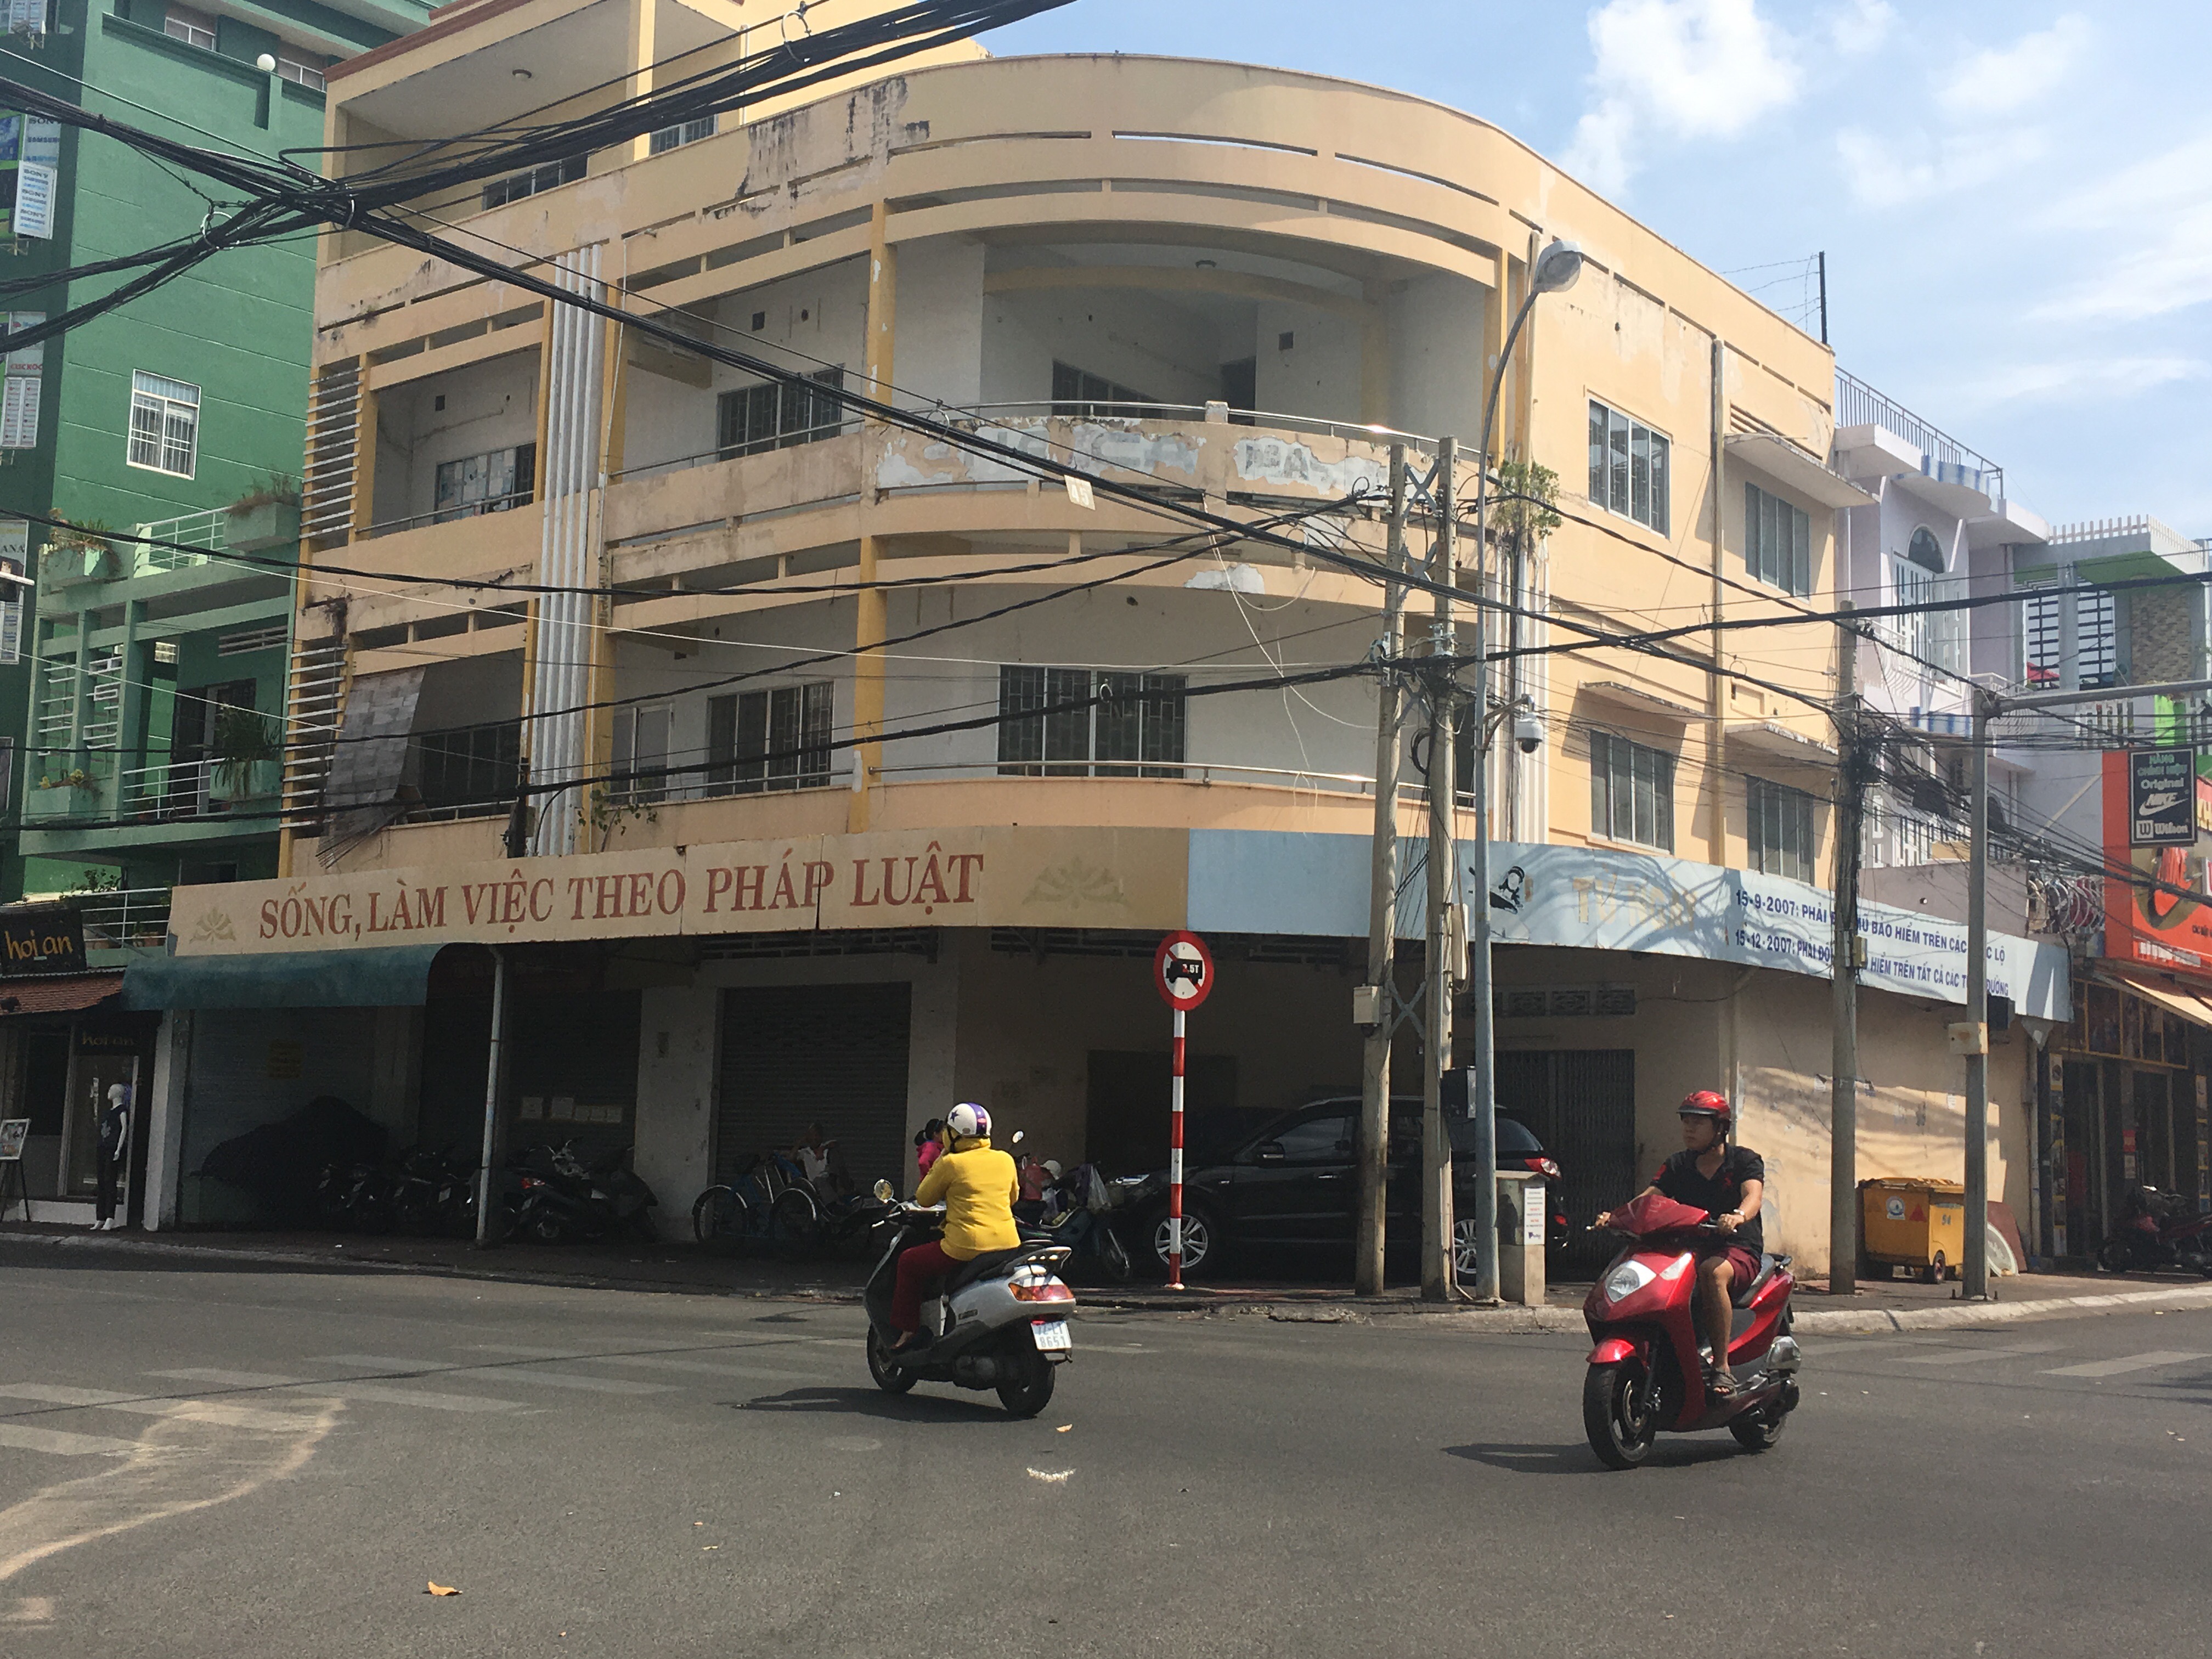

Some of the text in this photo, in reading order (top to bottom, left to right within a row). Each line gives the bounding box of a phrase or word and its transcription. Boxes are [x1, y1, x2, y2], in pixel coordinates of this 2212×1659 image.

[2141, 777, 2184, 791] Original
[2146, 792, 2178, 806] NIKE
[2154, 821, 2188, 834] Wilson
[259, 840, 984, 942] SỐNG, LÀM VIỆC THEO PHÁP LUẬT
[1736, 889, 1799, 917] 15-9-2007:
[1802, 902, 1827, 923] PHẢI
[1872, 916, 1892, 938] BẢO
[1895, 922, 1920, 944] HIỂM
[1922, 930, 1947, 950] TRÊN
[1949, 935, 1967, 953] CÁC
[1995, 945, 2005, 966] LỘ
[4, 929, 74, 960] hoi an
[1735, 929, 1795, 955] 15-12-2007:
[1870, 951, 1891, 975] HIỂM
[1893, 959, 1915, 979] TRÊN
[1917, 961, 1931, 982] TẤT
[1933, 964, 1944, 984] CẢ
[1945, 968, 1960, 988] CÁC
[1039, 1336, 1066, 1348] 8651
